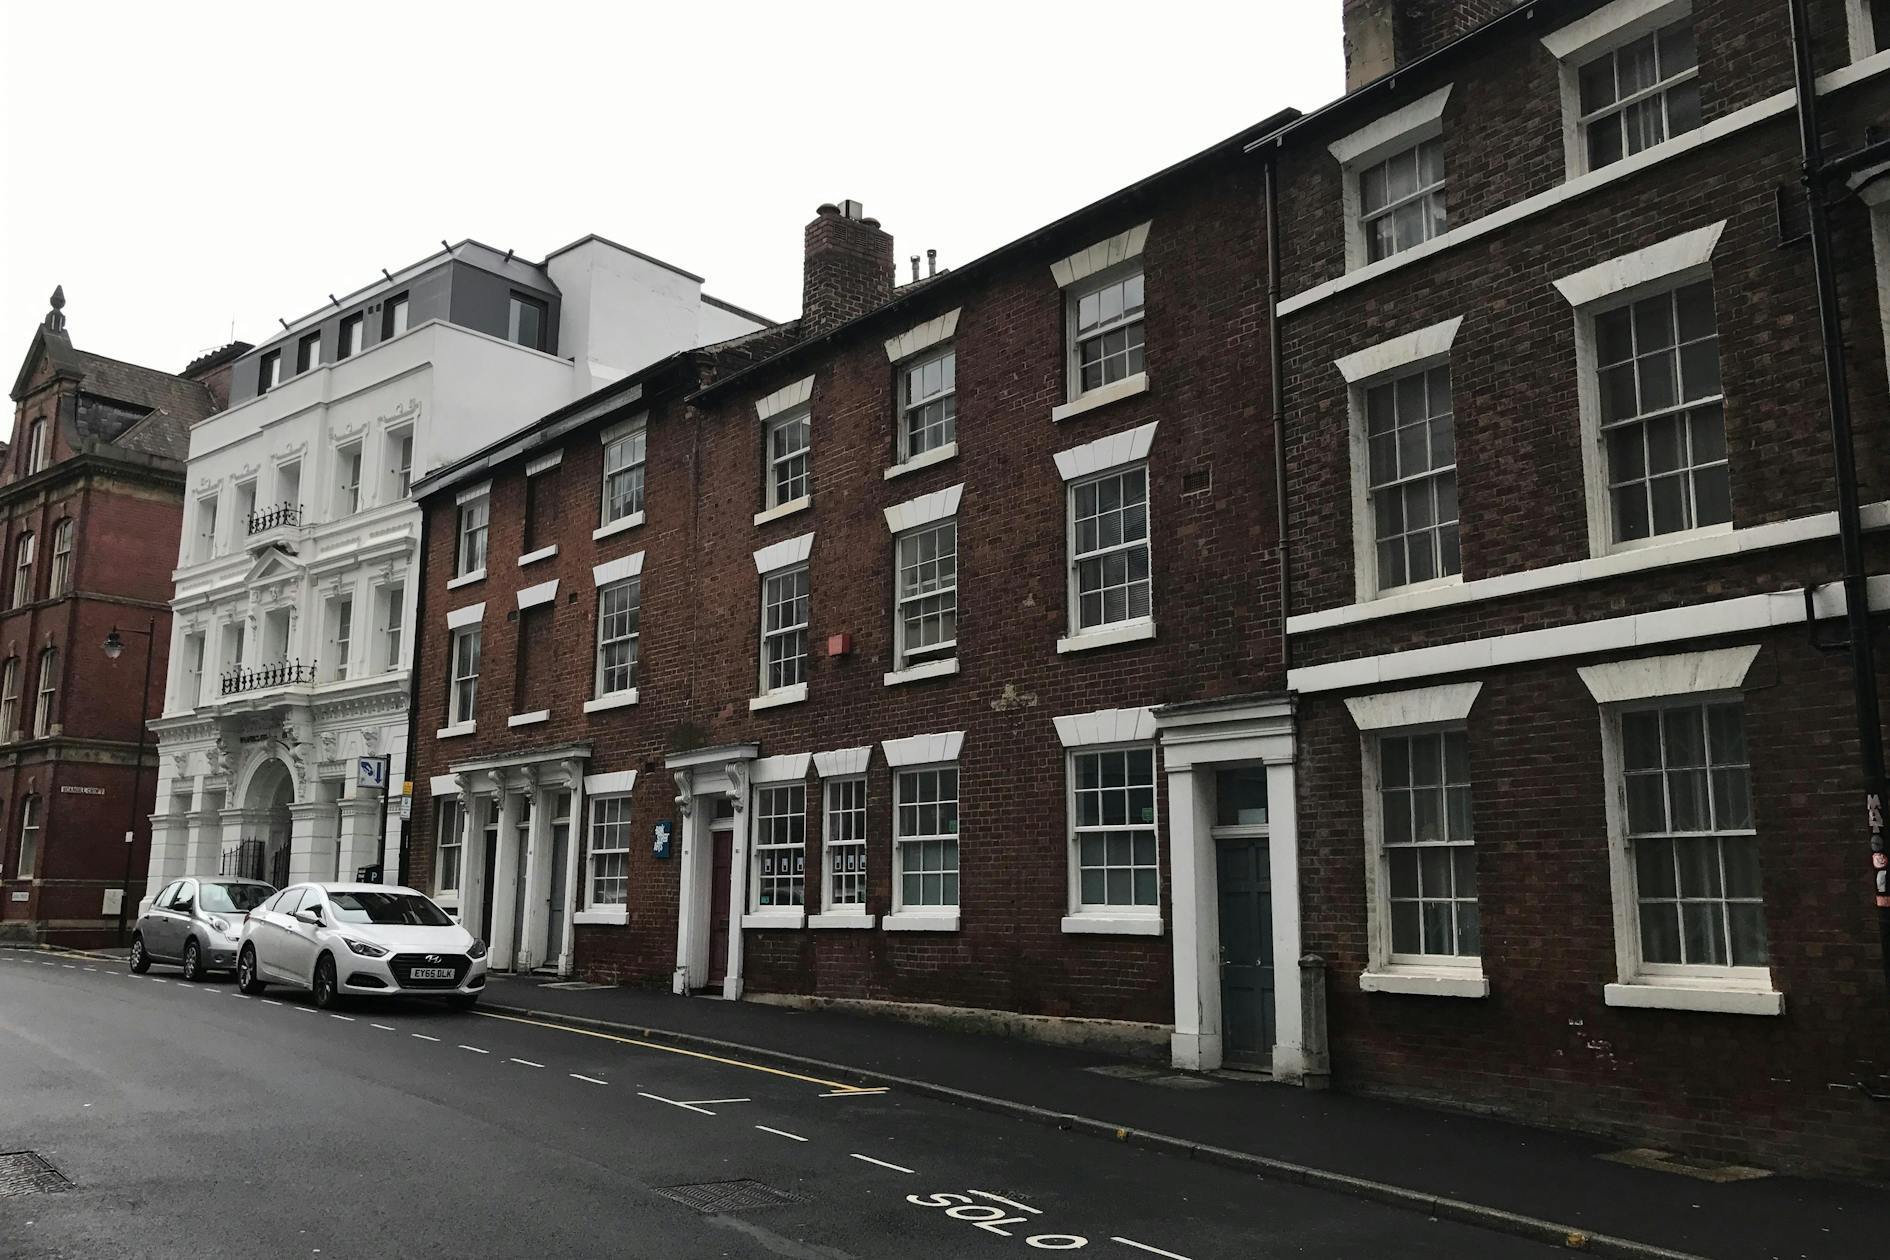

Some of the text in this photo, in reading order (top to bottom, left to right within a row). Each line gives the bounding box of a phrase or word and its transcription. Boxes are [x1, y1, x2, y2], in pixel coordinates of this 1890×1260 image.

[371, 872, 378, 881] P
[414, 969, 436, 978] EY65
[906, 1192, 1089, 1249] SOLO
